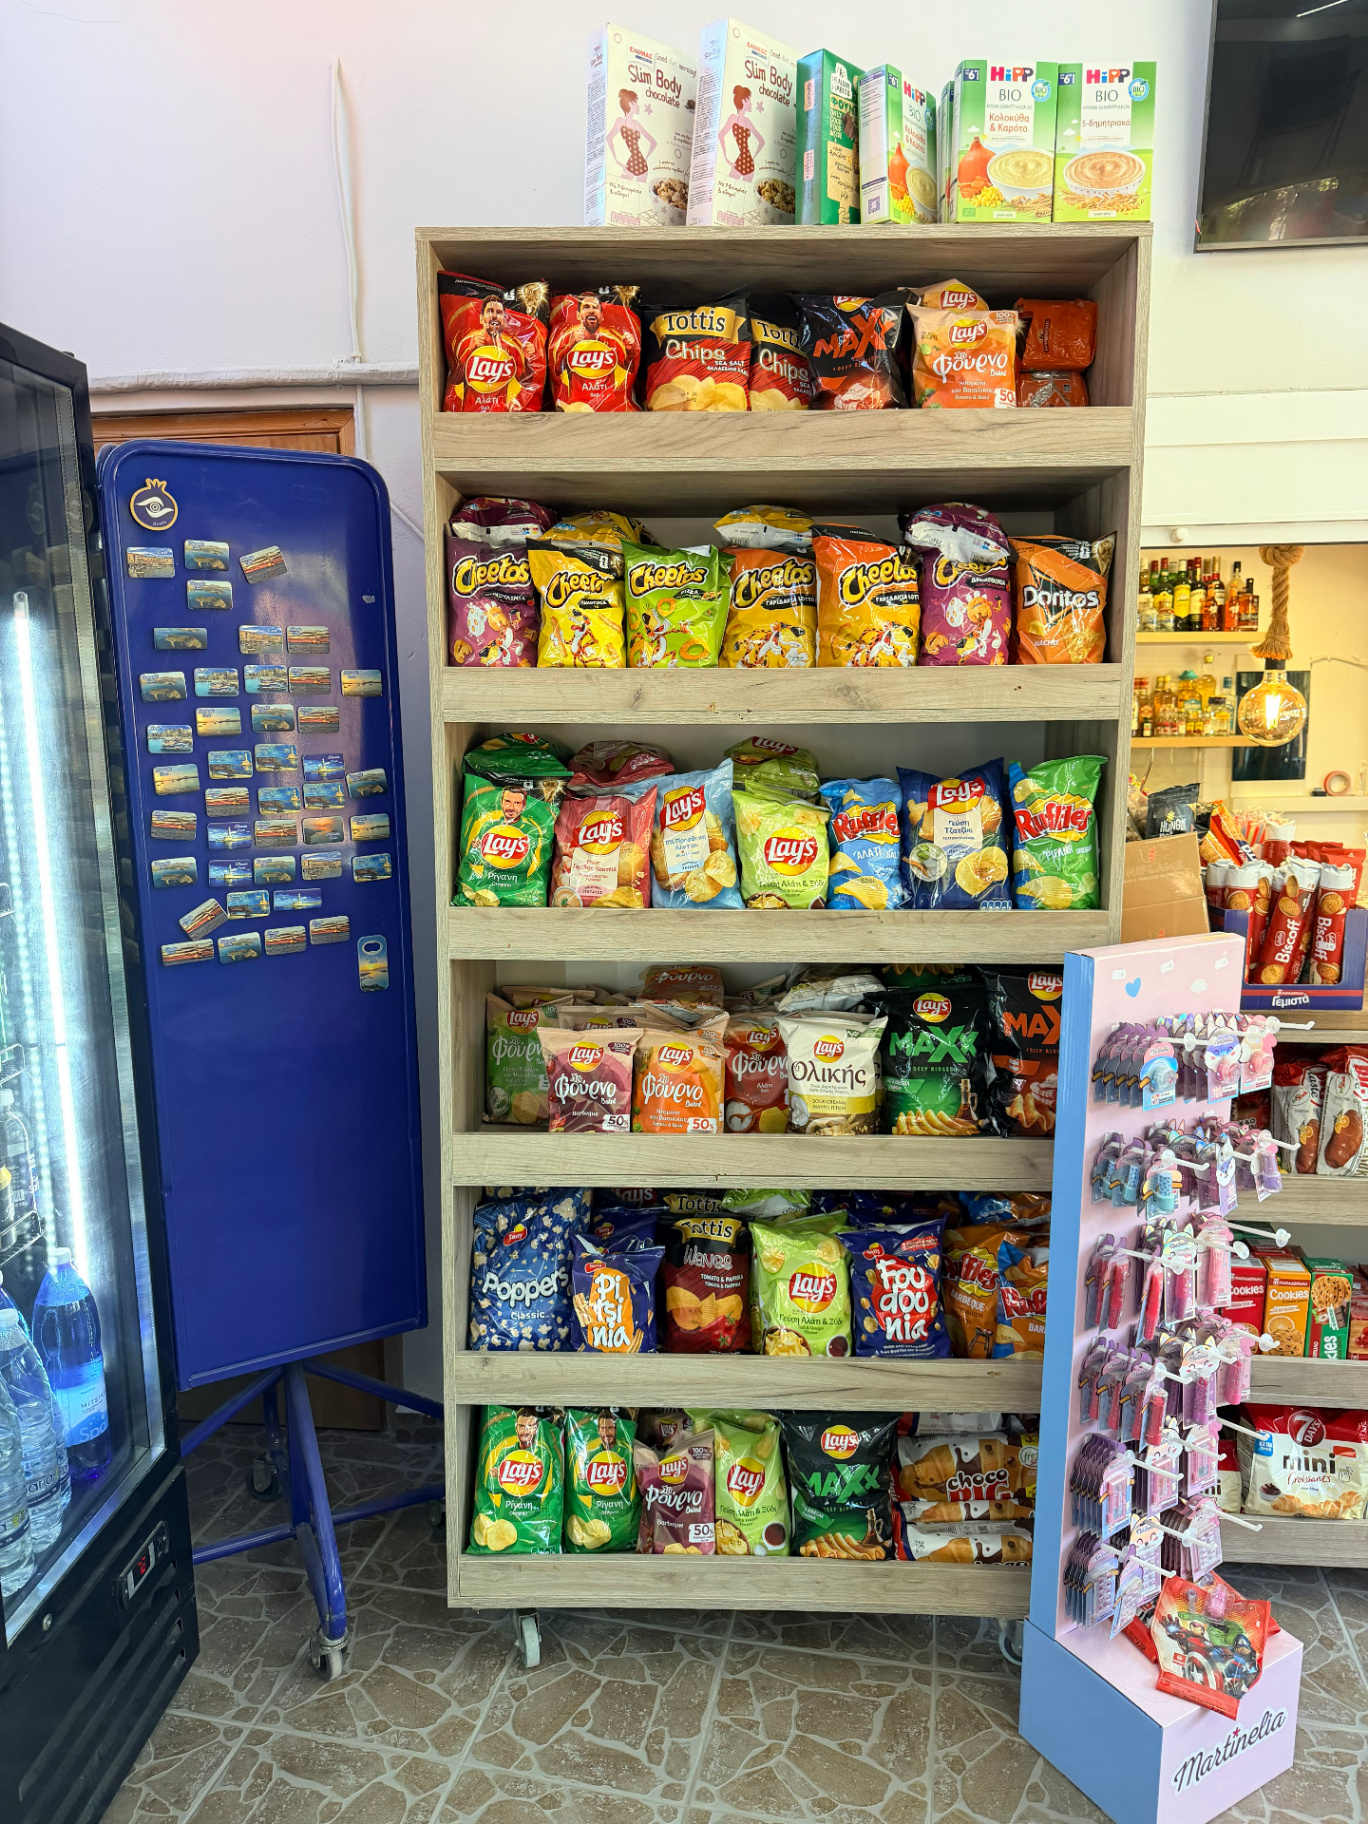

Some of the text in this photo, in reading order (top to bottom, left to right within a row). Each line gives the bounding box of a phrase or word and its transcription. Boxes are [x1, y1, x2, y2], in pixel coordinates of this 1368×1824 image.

[627, 64, 682, 99] Slim Body
[744, 59, 793, 97] Slim Body
[990, 66, 1034, 83] HiPP
[1086, 68, 1131, 84] HiPP
[645, 86, 680, 109] chocolate
[759, 82, 790, 107] chocolate
[903, 80, 926, 107] HiPP
[998, 88, 1022, 102] BIO
[1095, 89, 1119, 103] BIO
[908, 104, 922, 123] BIO
[989, 112, 1030, 123] Κολοκύθα
[989, 123, 1028, 135] & Καρότο
[941, 290, 976, 310] Lay's
[663, 310, 726, 333] Tottis
[951, 322, 986, 344] Lay's
[570, 350, 615, 370] Lay's
[665, 338, 726, 365] Chips
[468, 356, 514, 384] Lay's
[759, 348, 810, 385] Chips
[932, 353, 1009, 384] Φούρνο
[582, 381, 607, 392] Αλάτι
[999, 389, 1015, 403] 50
[474, 395, 499, 405] Αλάτι
[453, 553, 532, 598] Cheetos
[629, 560, 709, 598] Cheetos
[734, 557, 816, 609] Cheetos
[839, 551, 918, 607] Cheetos
[680, 589, 698, 597] PIZZA
[1022, 586, 1101, 610] Doritos
[1034, 637, 1060, 647] NACHO
[937, 780, 982, 807] Lay's
[665, 791, 703, 827] Lay's
[577, 818, 624, 846] Lay's
[948, 820, 970, 829] Γεύση
[1014, 801, 1093, 844] Ruffles
[481, 832, 530, 860] Lay's
[768, 836, 818, 867] Lay's
[487, 872, 518, 884] Ρίγανη
[1274, 917, 1301, 964] Biscoff
[917, 999, 949, 1017] Lay's
[1271, 993, 1311, 1008] Γεμιστά
[508, 1011, 538, 1028] Lay's
[748, 1026, 777, 1046] Lay's
[888, 1024, 981, 1065] MAXX
[570, 1046, 602, 1065] Lay's
[659, 1046, 693, 1066] Lay's
[814, 1040, 844, 1059] Lay's
[790, 1059, 867, 1091] Ολικής
[554, 1072, 617, 1105] Φούρνο
[641, 1071, 704, 1105] Φούρνο
[507, 1231, 524, 1244] Tasty
[681, 1219, 734, 1239] Tottis
[683, 1244, 734, 1271] Waves
[481, 1266, 569, 1309] Poppers
[594, 1273, 622, 1301] Pi
[700, 1274, 720, 1283] TOMATO
[720, 1275, 726, 1283] &
[790, 1273, 835, 1304] Lay's
[951, 1287, 987, 1313] BARBEQUE
[1269, 1288, 1309, 1301] Cookies
[510, 1310, 545, 1320] Classic
[592, 1324, 631, 1349] nia
[1294, 1415, 1322, 1445] 7 DAYS
[824, 1432, 859, 1452] Lay's
[660, 1458, 688, 1478] Lay's
[1282, 1449, 1336, 1474] mini
[501, 1462, 541, 1487] Lay's
[589, 1462, 626, 1486] Lay's
[946, 1468, 1009, 1491] choco
[1287, 1471, 1332, 1485] Croissants
[505, 1500, 533, 1512] Ρίγανη
[596, 1500, 624, 1512] Ρίγανη
[645, 1484, 703, 1512] Φούρνο
[1173, 1706, 1288, 1794] Martinelia
